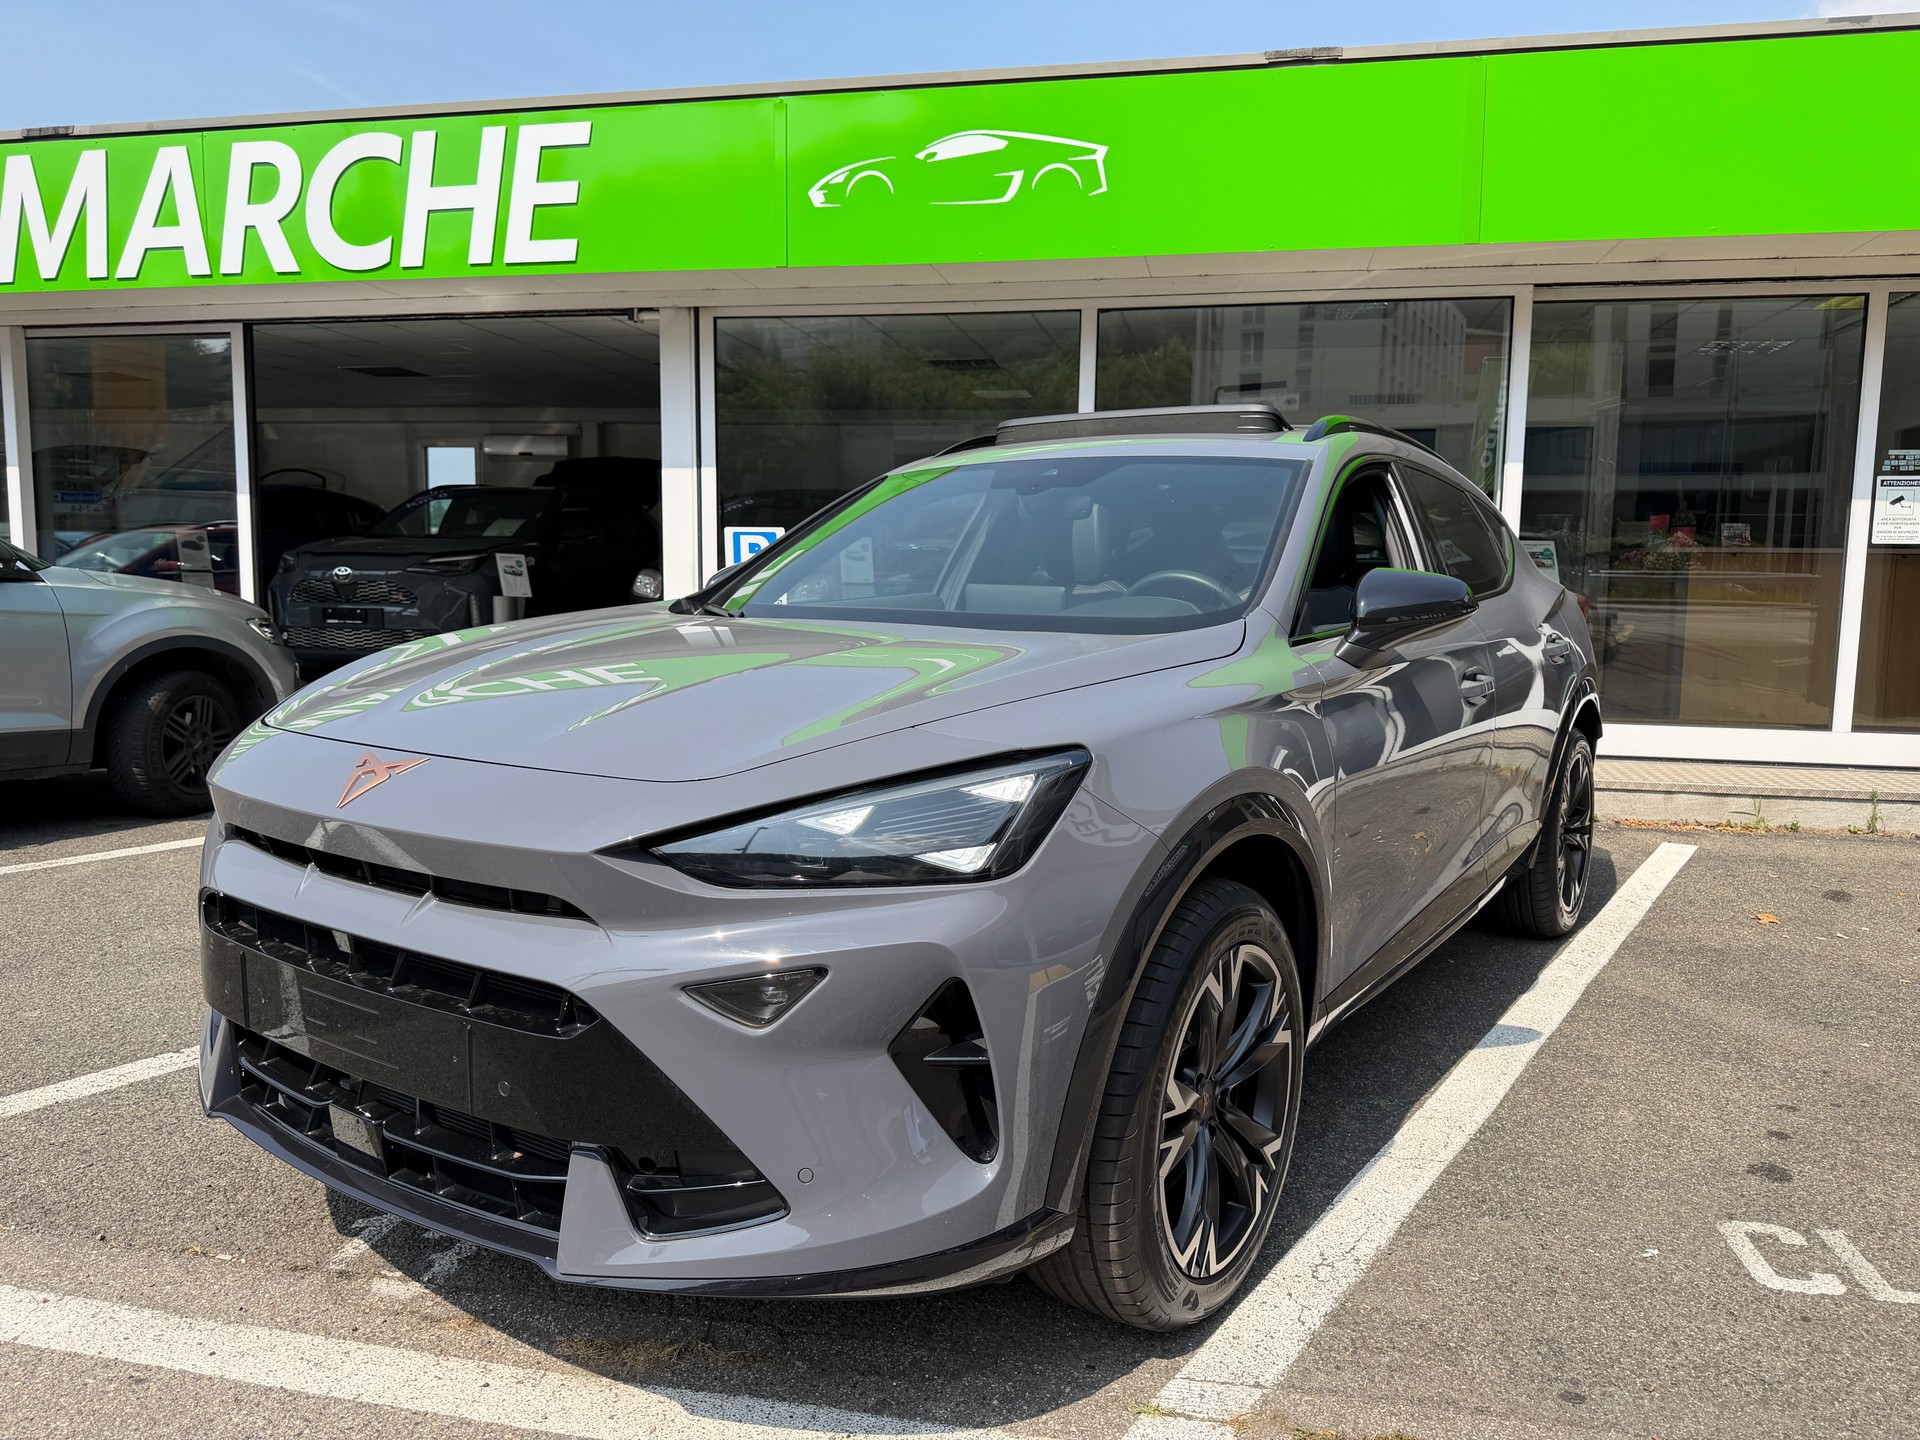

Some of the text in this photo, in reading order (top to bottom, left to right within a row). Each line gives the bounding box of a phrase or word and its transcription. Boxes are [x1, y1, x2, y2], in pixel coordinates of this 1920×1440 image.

[0, 121, 592, 283] MARCHE
[739, 535, 769, 564] P
[1715, 1220, 1920, 1304] CL
